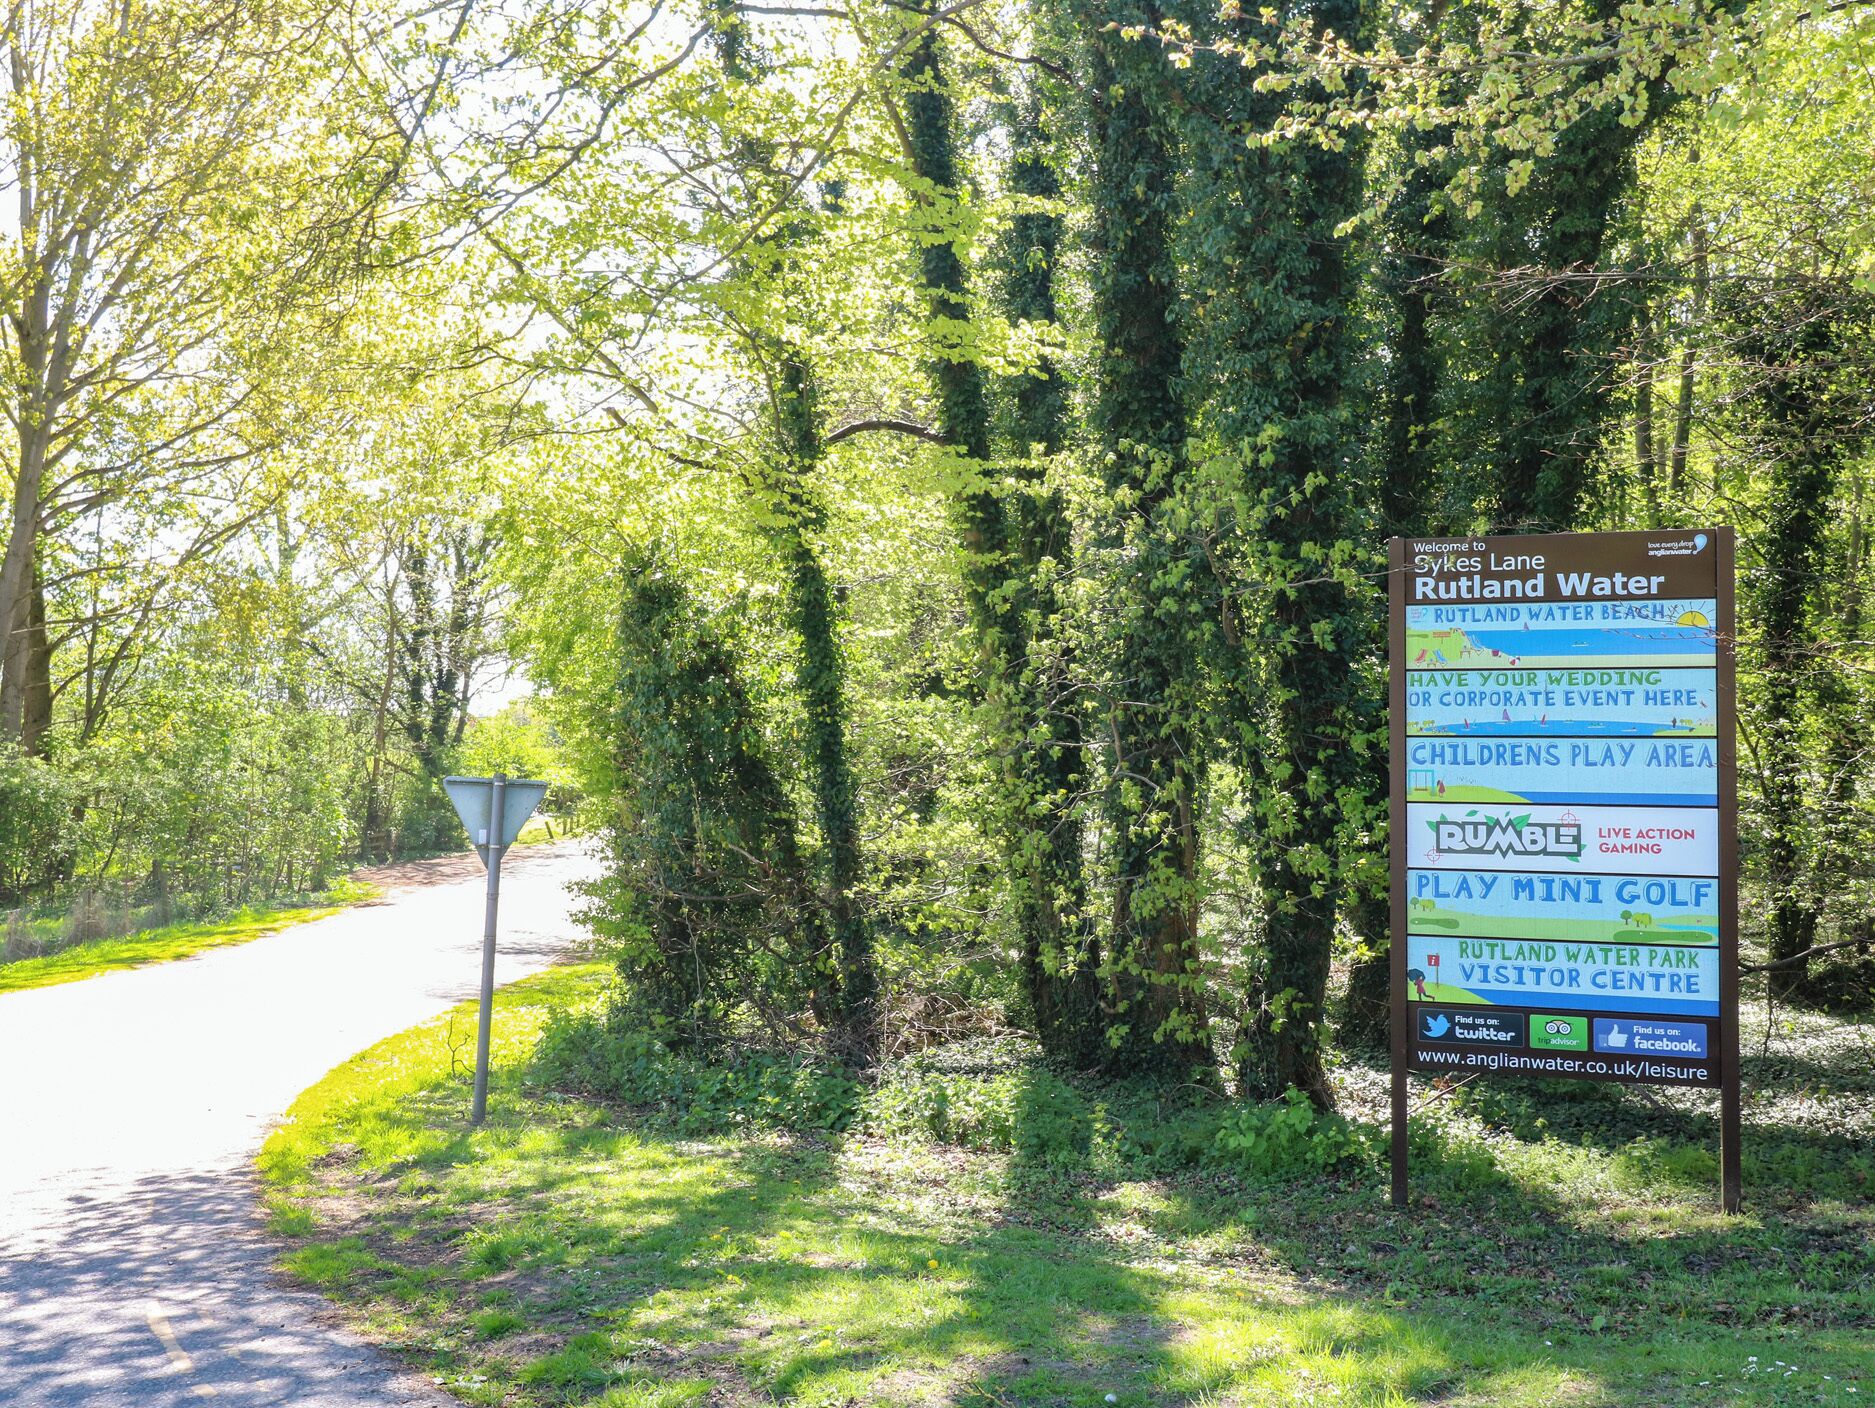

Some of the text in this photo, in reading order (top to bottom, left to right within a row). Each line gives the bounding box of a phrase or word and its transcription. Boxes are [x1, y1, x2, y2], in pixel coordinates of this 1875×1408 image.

[1413, 541, 1486, 553] Welcome to
[1648, 549, 1692, 557] anglianwater
[1679, 540, 1694, 548] drop
[1414, 552, 1545, 577] Sykes Lane
[1415, 572, 1665, 600] Rutland Water
[1434, 607, 1520, 623] RUTLAND
[1528, 604, 1594, 621] WATER
[1600, 602, 1665, 620] BEACH
[1409, 670, 1661, 688] HAVE YOUR WEDDING
[1409, 688, 1697, 707] OR CORPORATE EVENT HERE
[1410, 742, 1714, 768] CHILDRENS PLAY AREA
[1436, 817, 1581, 859] RUMBLE
[1598, 827, 1695, 840] LIVE ACTION
[1599, 842, 1662, 854] GAMING
[1416, 872, 1712, 907] PLAY MINI GOLF
[1458, 940, 1700, 969] RUTLAND WATER PARK
[1459, 962, 1700, 994] VISITOR CENTRE
[1455, 1015, 1473, 1024] Find
[1486, 1018, 1500, 1026] on:
[1455, 1026, 1516, 1042] twitter
[1633, 1025, 1681, 1037] Find us on:
[1418, 1050, 1708, 1080] www.anglianwater.co.uk/leisure
